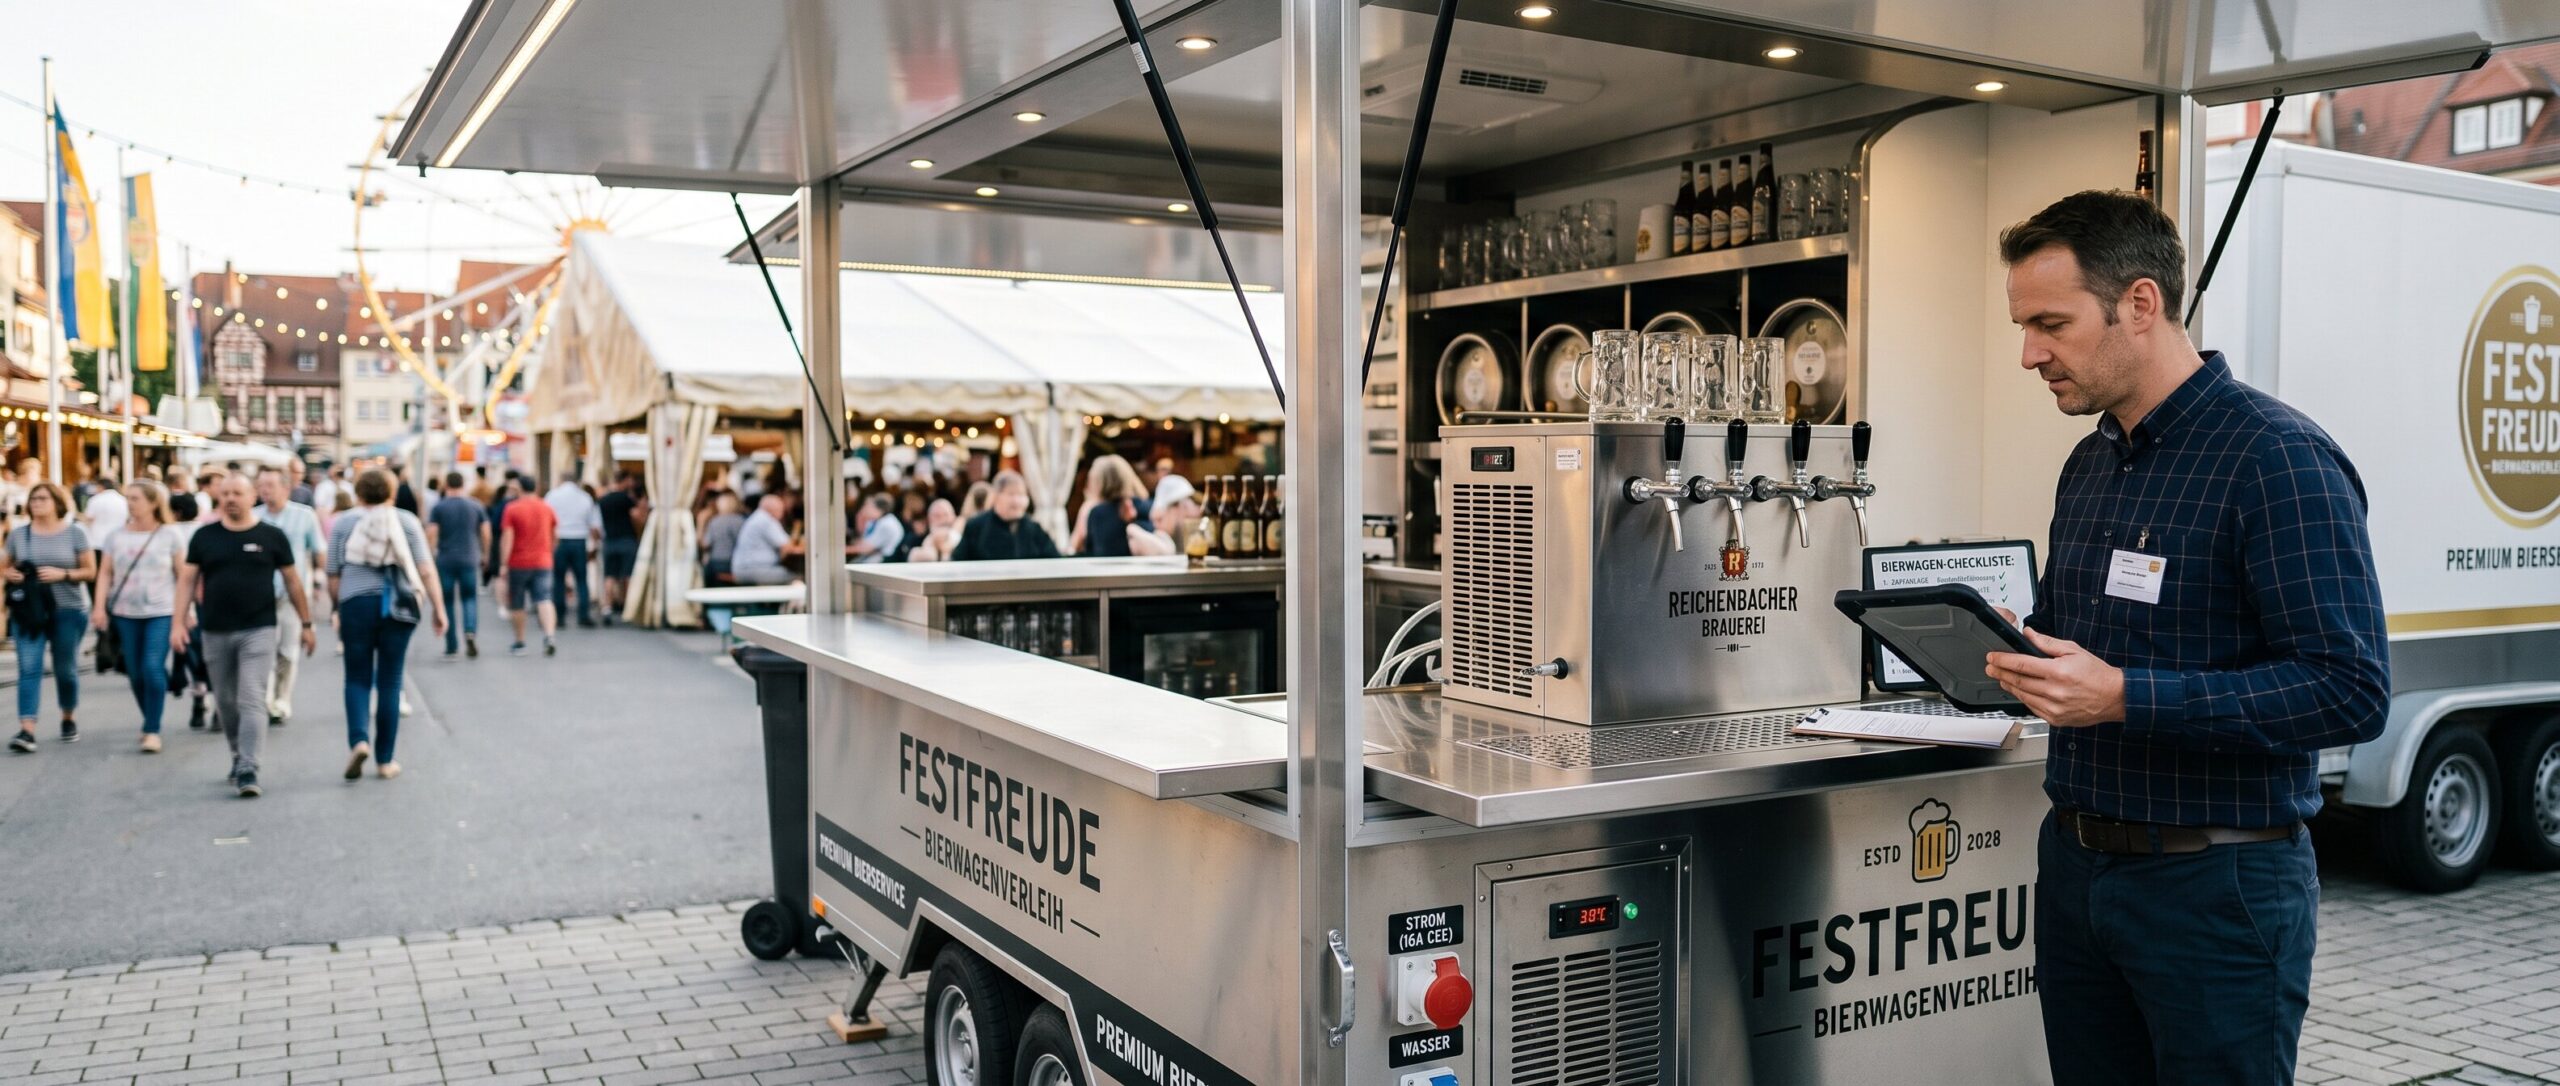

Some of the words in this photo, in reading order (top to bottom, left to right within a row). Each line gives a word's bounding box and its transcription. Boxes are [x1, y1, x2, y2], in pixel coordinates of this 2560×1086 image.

[2483, 340, 2560, 403] FEST
[2482, 408, 2560, 453] FREUD
[1881, 555, 2015, 573] BIERWAGEN-CHECKLISTE:
[2446, 547, 2511, 571] PREMIUM
[1891, 577, 1929, 586] ZAPFANLAGE
[1669, 586, 1798, 618] REICHENBACHER
[1702, 616, 1765, 637] BRAUEREI
[900, 731, 1100, 893] FESTFREUDE
[1864, 845, 1901, 867] ESTD
[1967, 829, 2001, 851] 2028
[820, 833, 853, 875] PREMIUM
[854, 855, 906, 909] BIERSERVICE
[925, 827, 1063, 934] BIERWAGENVERLEIH
[1399, 934, 1424, 950] (16A
[1427, 927, 1453, 944] CEE)
[1406, 912, 1446, 931] STROM
[1753, 882, 2037, 999] FESTFREU
[1814, 965, 2037, 1039] BIERWAGENVERLEIH
[1096, 1013, 1164, 1086] PREMIUM
[1402, 1035, 1450, 1057] WASSER
